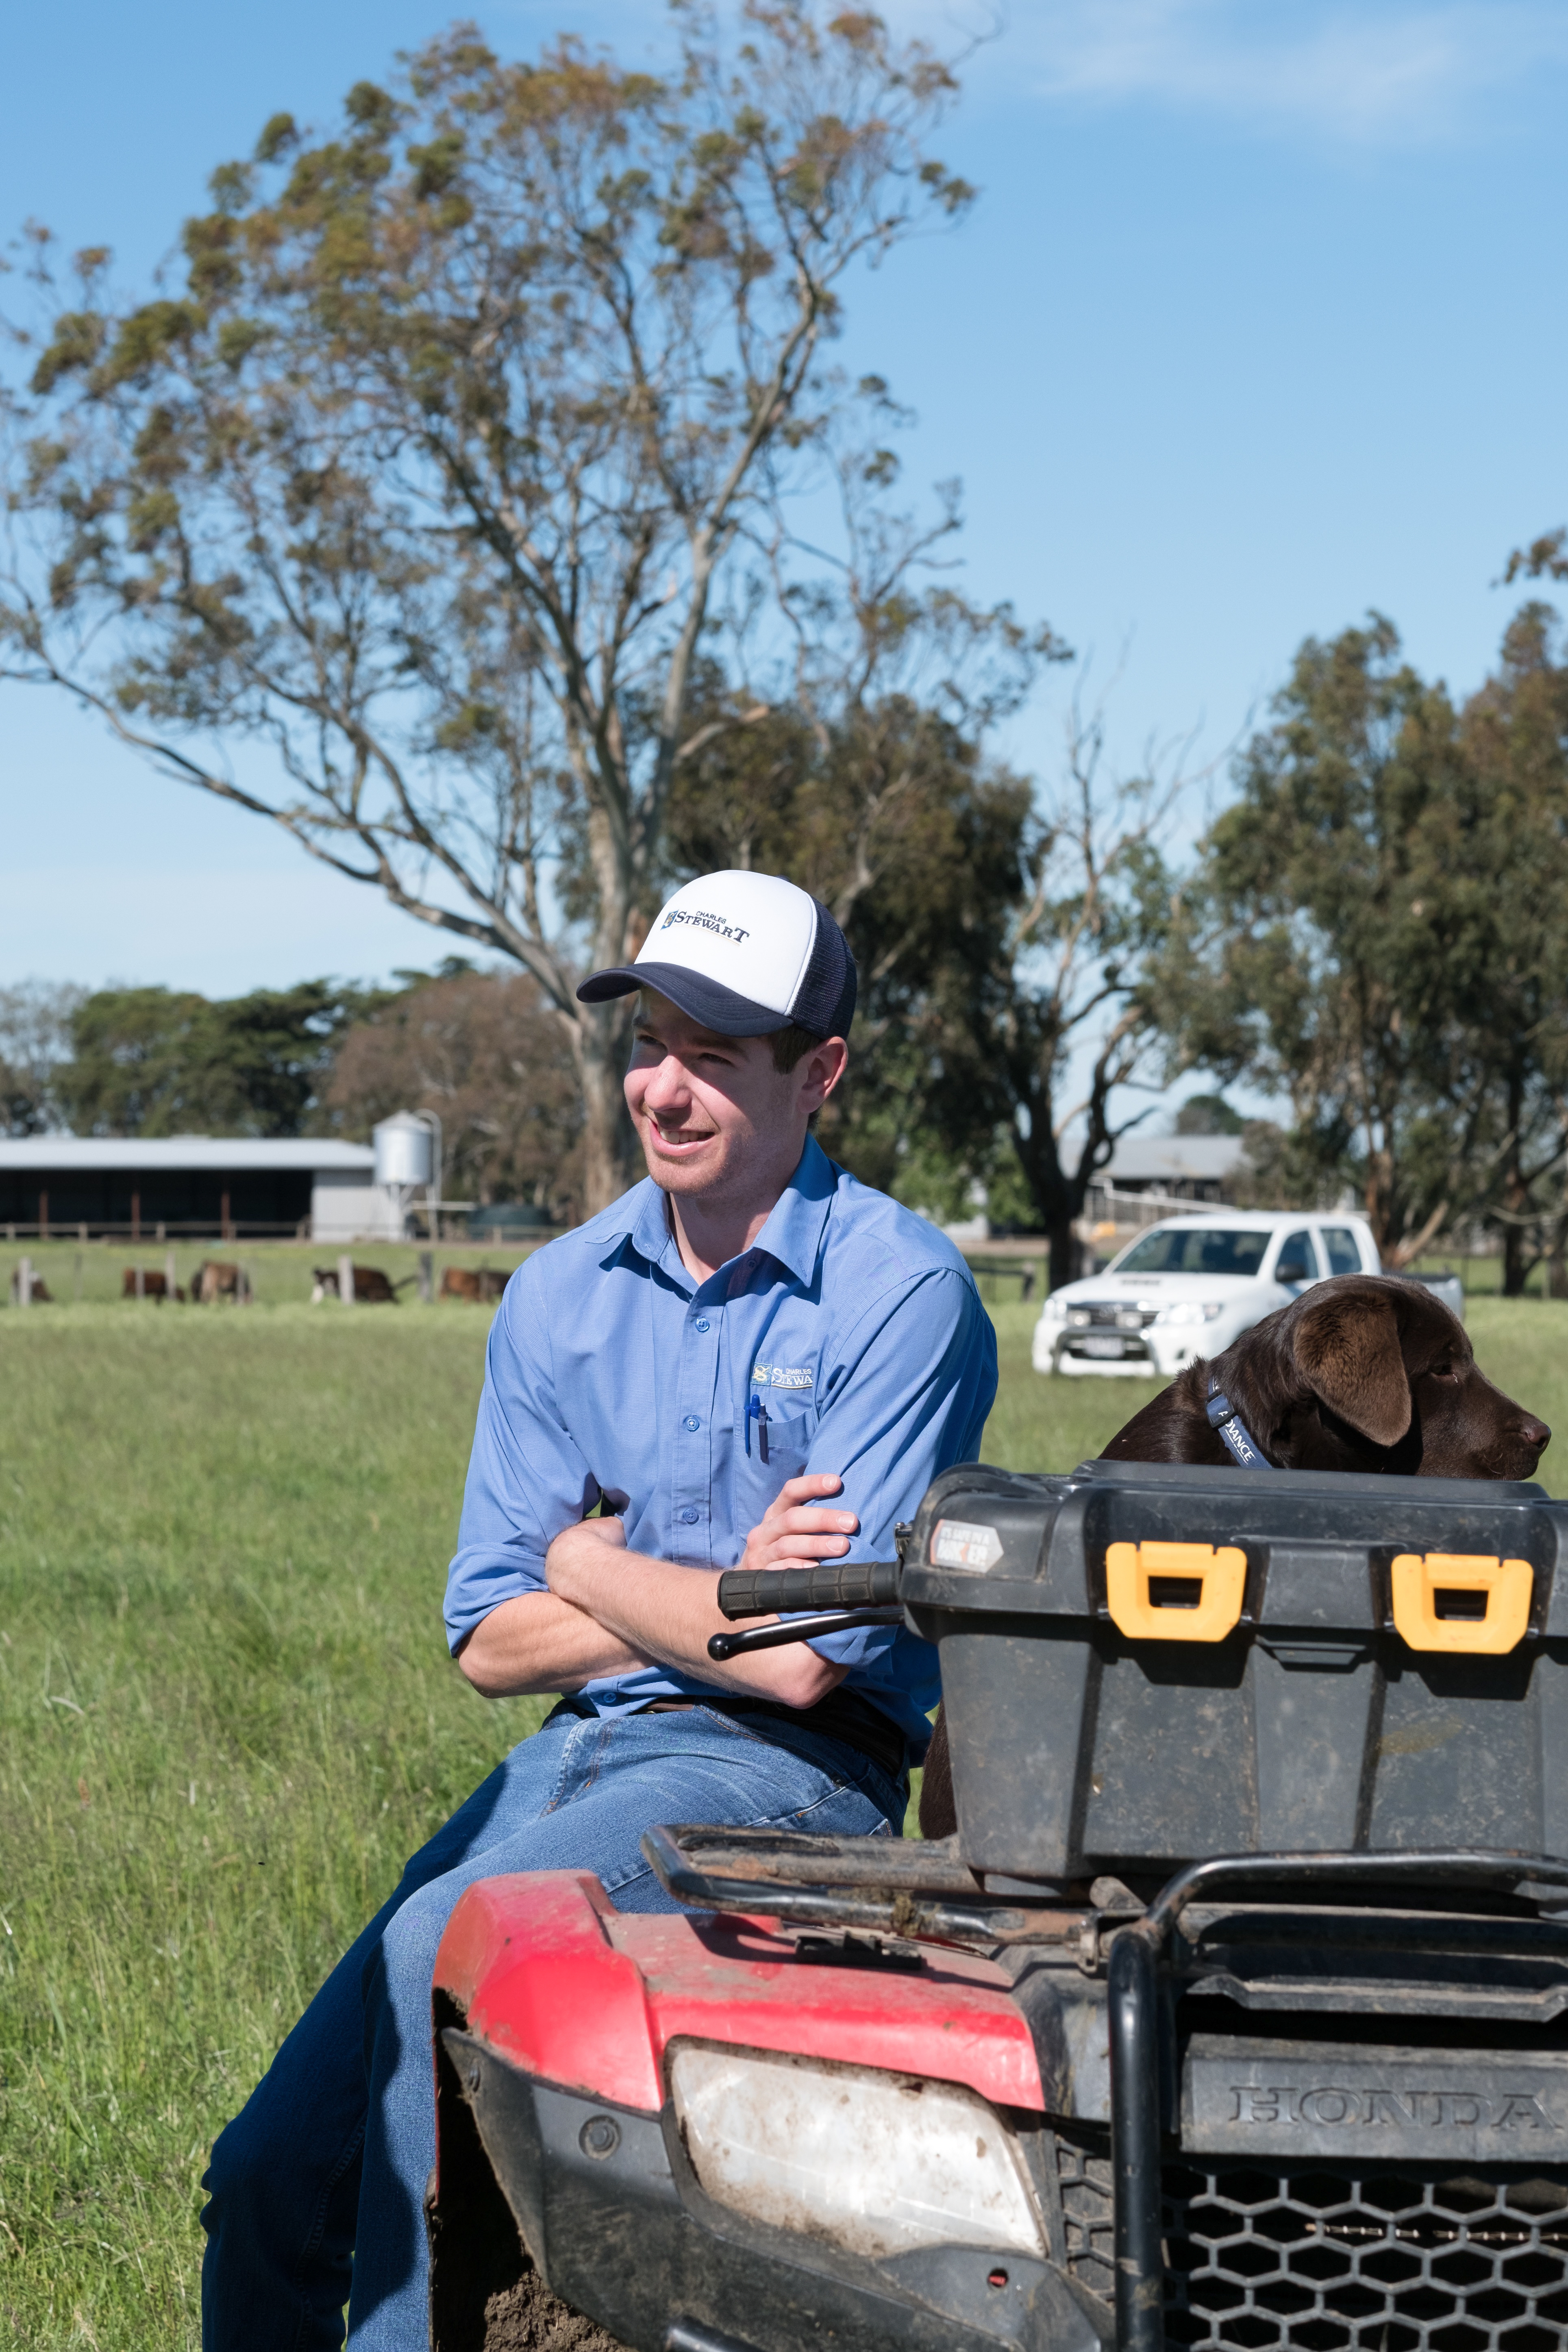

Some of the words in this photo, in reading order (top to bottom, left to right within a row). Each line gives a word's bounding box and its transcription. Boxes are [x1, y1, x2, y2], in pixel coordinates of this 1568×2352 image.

[674, 911, 750, 943] STEWART
[696, 911, 727, 924] CHARLES
[772, 1368, 813, 1385] STEWA
[1228, 2085, 1565, 2130] HONDA
